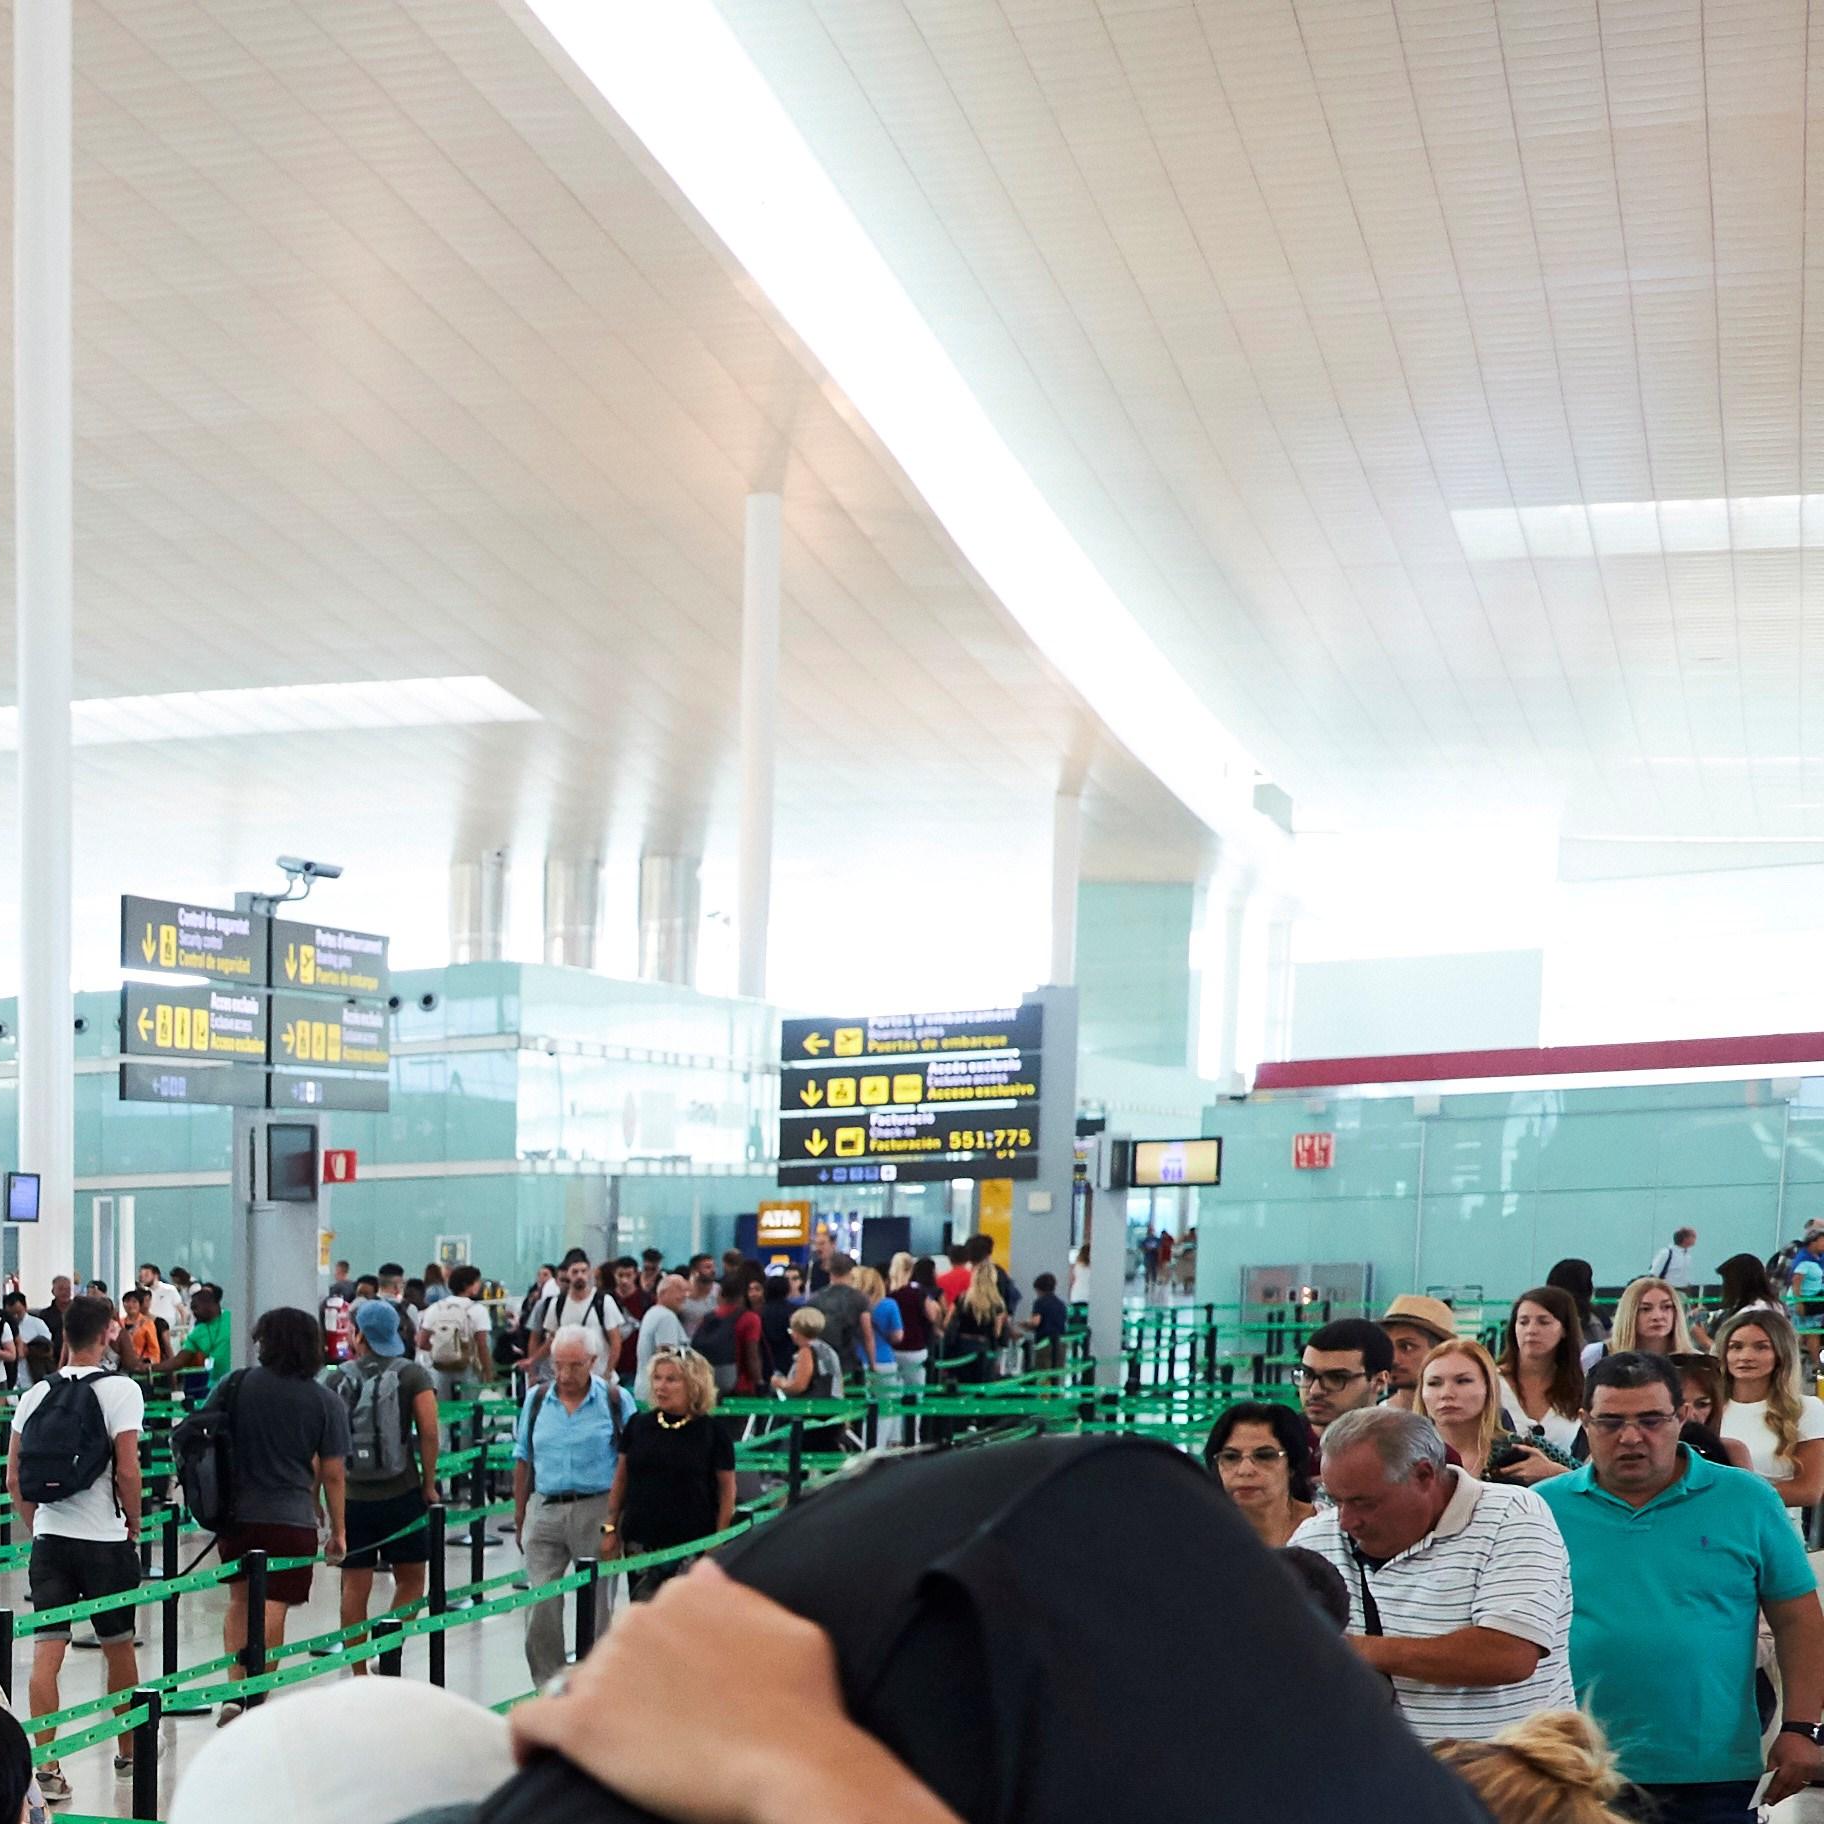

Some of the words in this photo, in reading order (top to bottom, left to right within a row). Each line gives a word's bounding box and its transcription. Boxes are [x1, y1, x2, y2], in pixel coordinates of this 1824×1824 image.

[920, 1038, 938, 1051] de
[948, 1131, 986, 1151] 551
[993, 1128, 1032, 1148] 775
[760, 1209, 802, 1228] ATM
